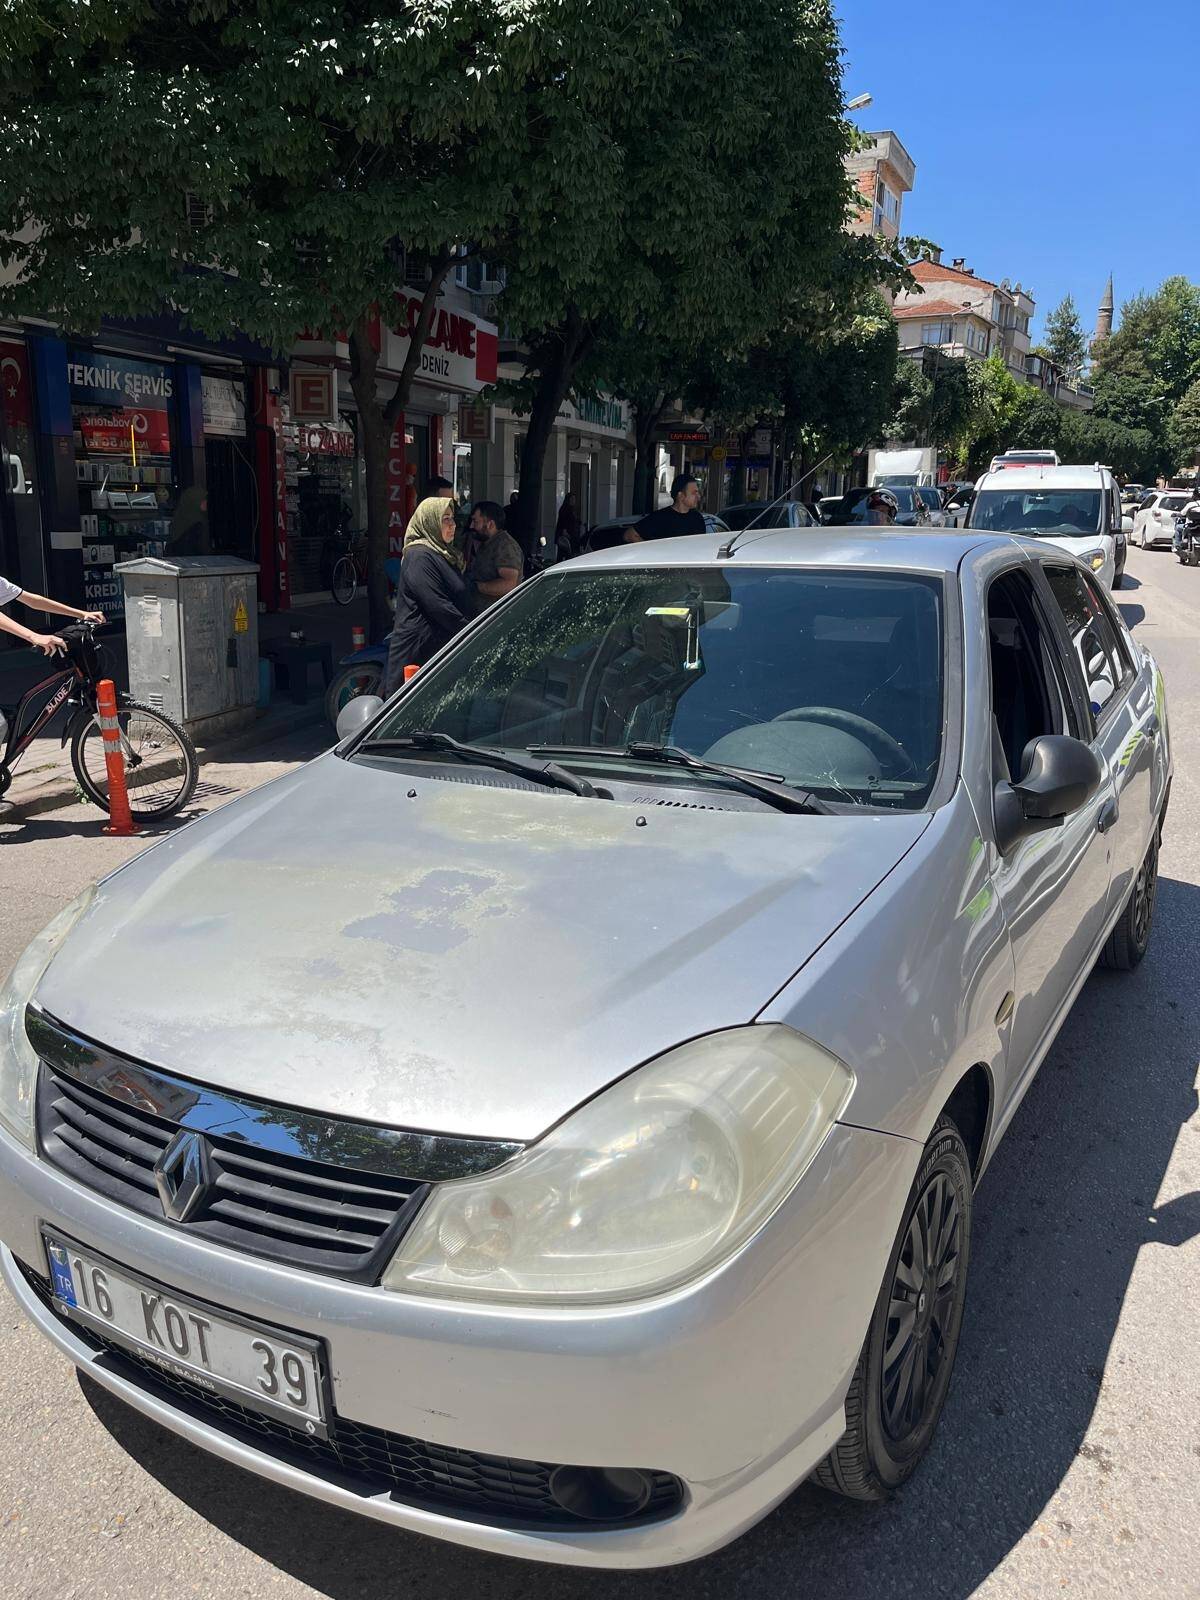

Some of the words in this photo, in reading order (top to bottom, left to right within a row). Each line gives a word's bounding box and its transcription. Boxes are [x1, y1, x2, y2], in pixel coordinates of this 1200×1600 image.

[67, 363, 121, 391] TEKNİK
[124, 371, 173, 398] SERVİS
[422, 354, 450, 377] DENİZ
[298, 428, 355, 459] ECZANE
[387, 432, 404, 554] ECZAN
[57, 1273, 73, 1293] TR
[73, 1257, 114, 1321] 16
[140, 1290, 211, 1367] KOT
[250, 1337, 308, 1408] 39
